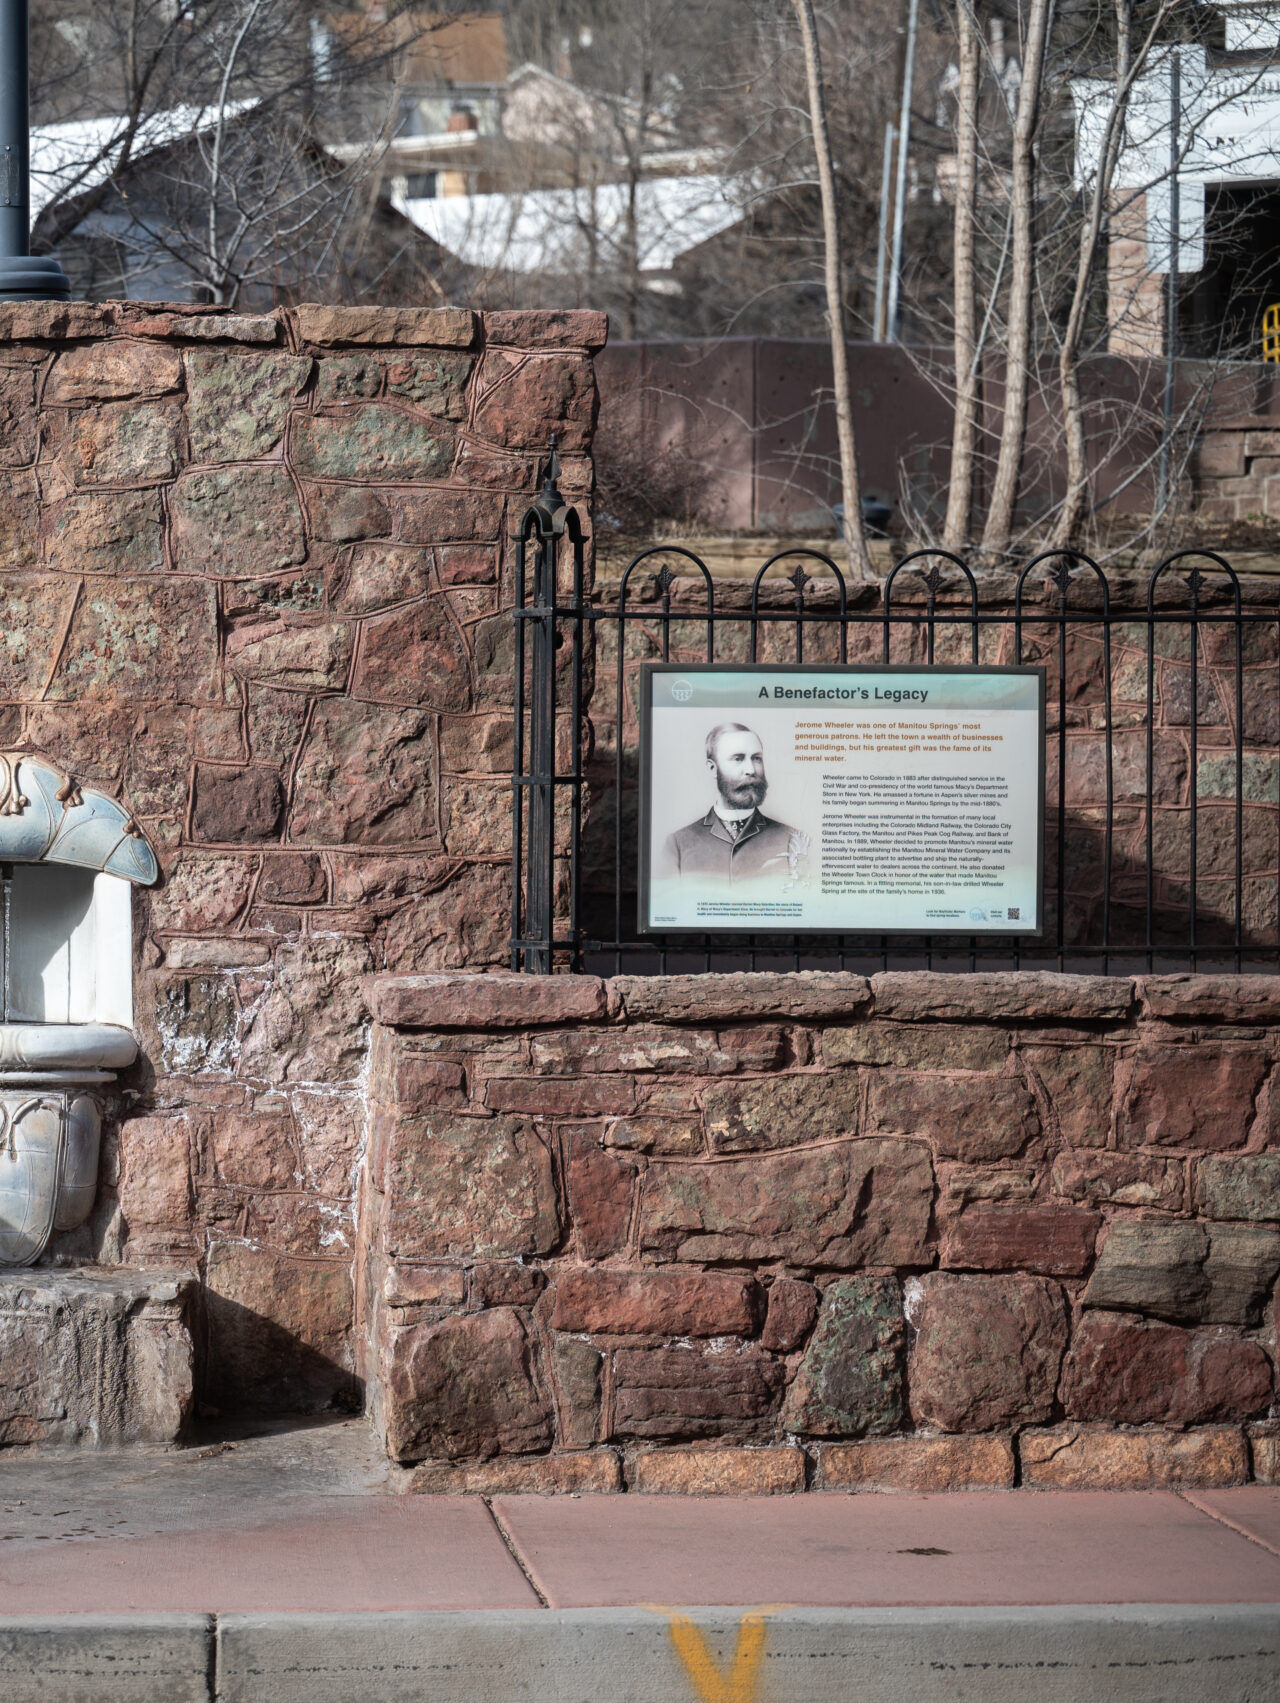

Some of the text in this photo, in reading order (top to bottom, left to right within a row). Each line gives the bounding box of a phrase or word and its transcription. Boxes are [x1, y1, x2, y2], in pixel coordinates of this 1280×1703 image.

[758, 686, 928, 703] A Benefactor’s Legacy
[831, 733, 860, 741] patrons.
[811, 744, 846, 752] buildings,
[877, 744, 907, 752] greatest
[909, 744, 920, 753] gift
